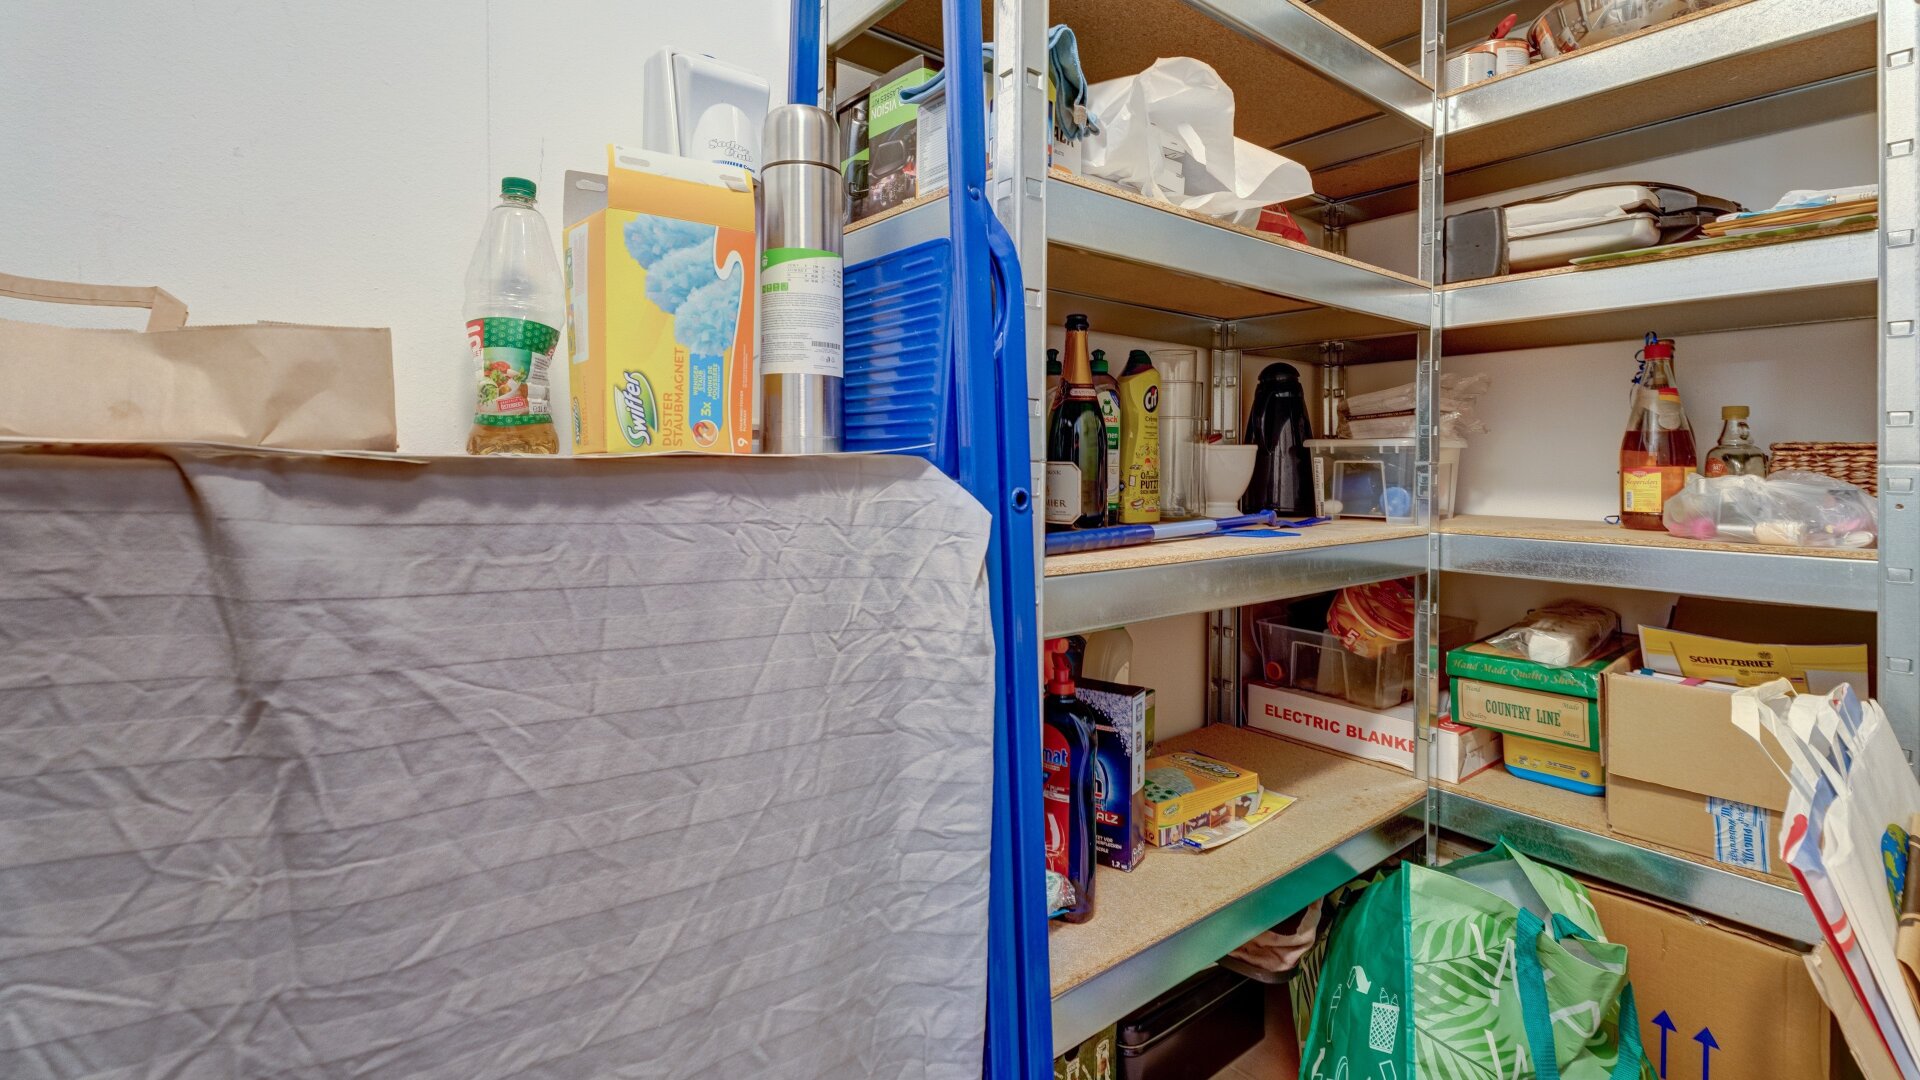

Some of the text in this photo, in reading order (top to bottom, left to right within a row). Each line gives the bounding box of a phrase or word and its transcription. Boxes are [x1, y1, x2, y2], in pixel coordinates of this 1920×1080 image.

[871, 98, 897, 121] VISION
[673, 346, 684, 447] STAUBMAGNET
[622, 371, 652, 446] Swiffer
[662, 392, 673, 447] DUSTER
[700, 401, 712, 417] 3x
[737, 437, 748, 447] 9
[1452, 659, 1478, 671] Hand
[1481, 663, 1508, 676] Made
[1511, 667, 1549, 684] Quality
[1688, 655, 1775, 668] SCHUTZBRIEF
[1264, 703, 1341, 734] ELECTRIC
[1485, 699, 1561, 728] COUNTRY LINE
[1043, 748, 1068, 767] mat
[1096, 811, 1119, 824] ALZ
[1111, 860, 1121, 869] 1.2
